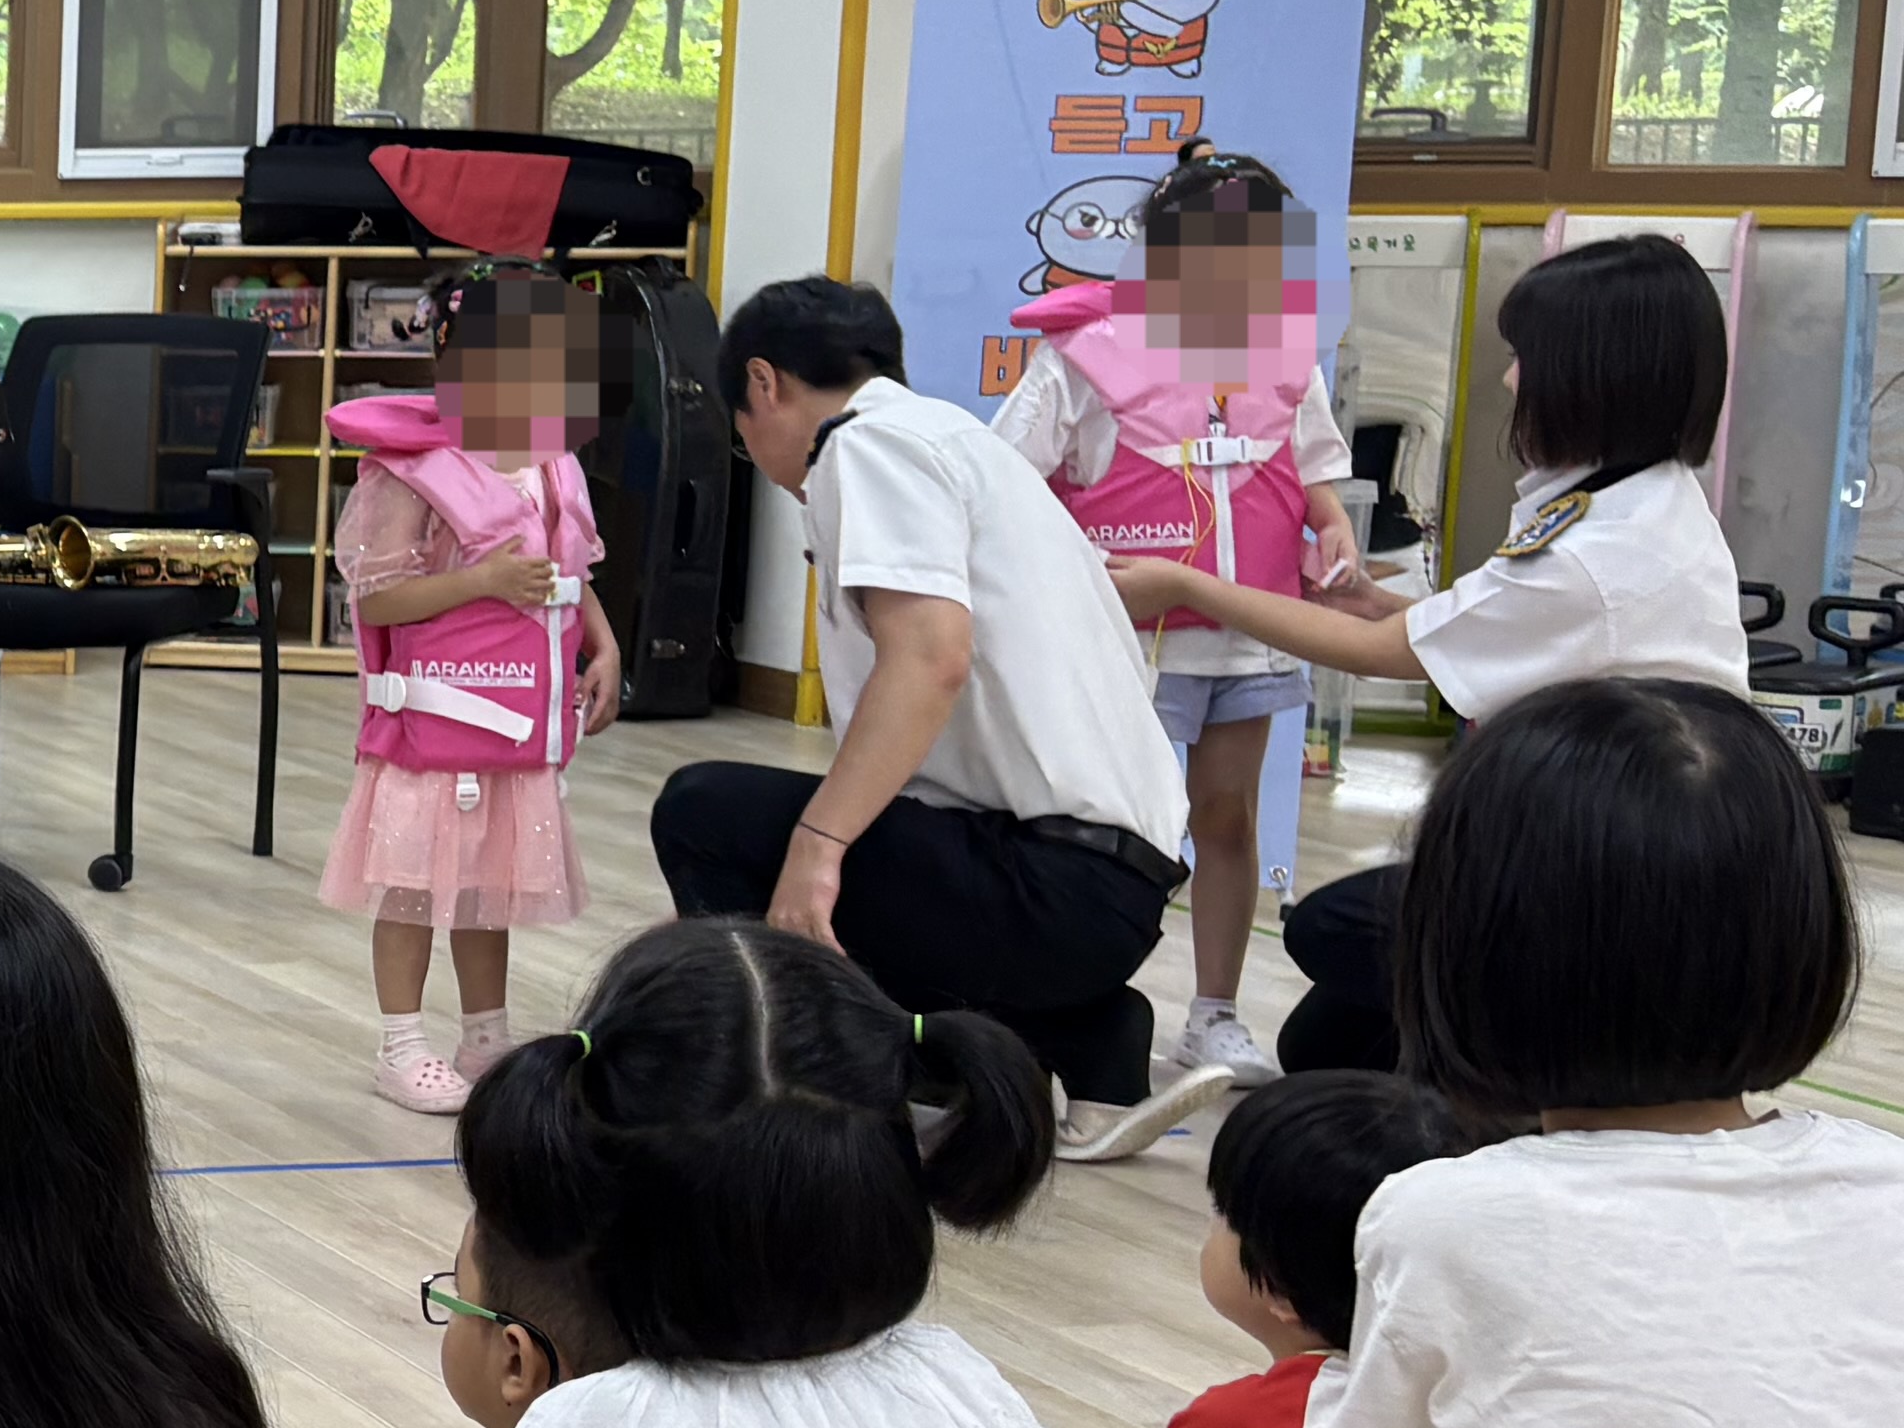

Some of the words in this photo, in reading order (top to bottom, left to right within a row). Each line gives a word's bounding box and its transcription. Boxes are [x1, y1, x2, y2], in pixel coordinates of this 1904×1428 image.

[1049, 95, 1204, 153] 들고
[1088, 521, 1193, 541] ARAKHAN
[424, 660, 536, 678] ARAKHAN
